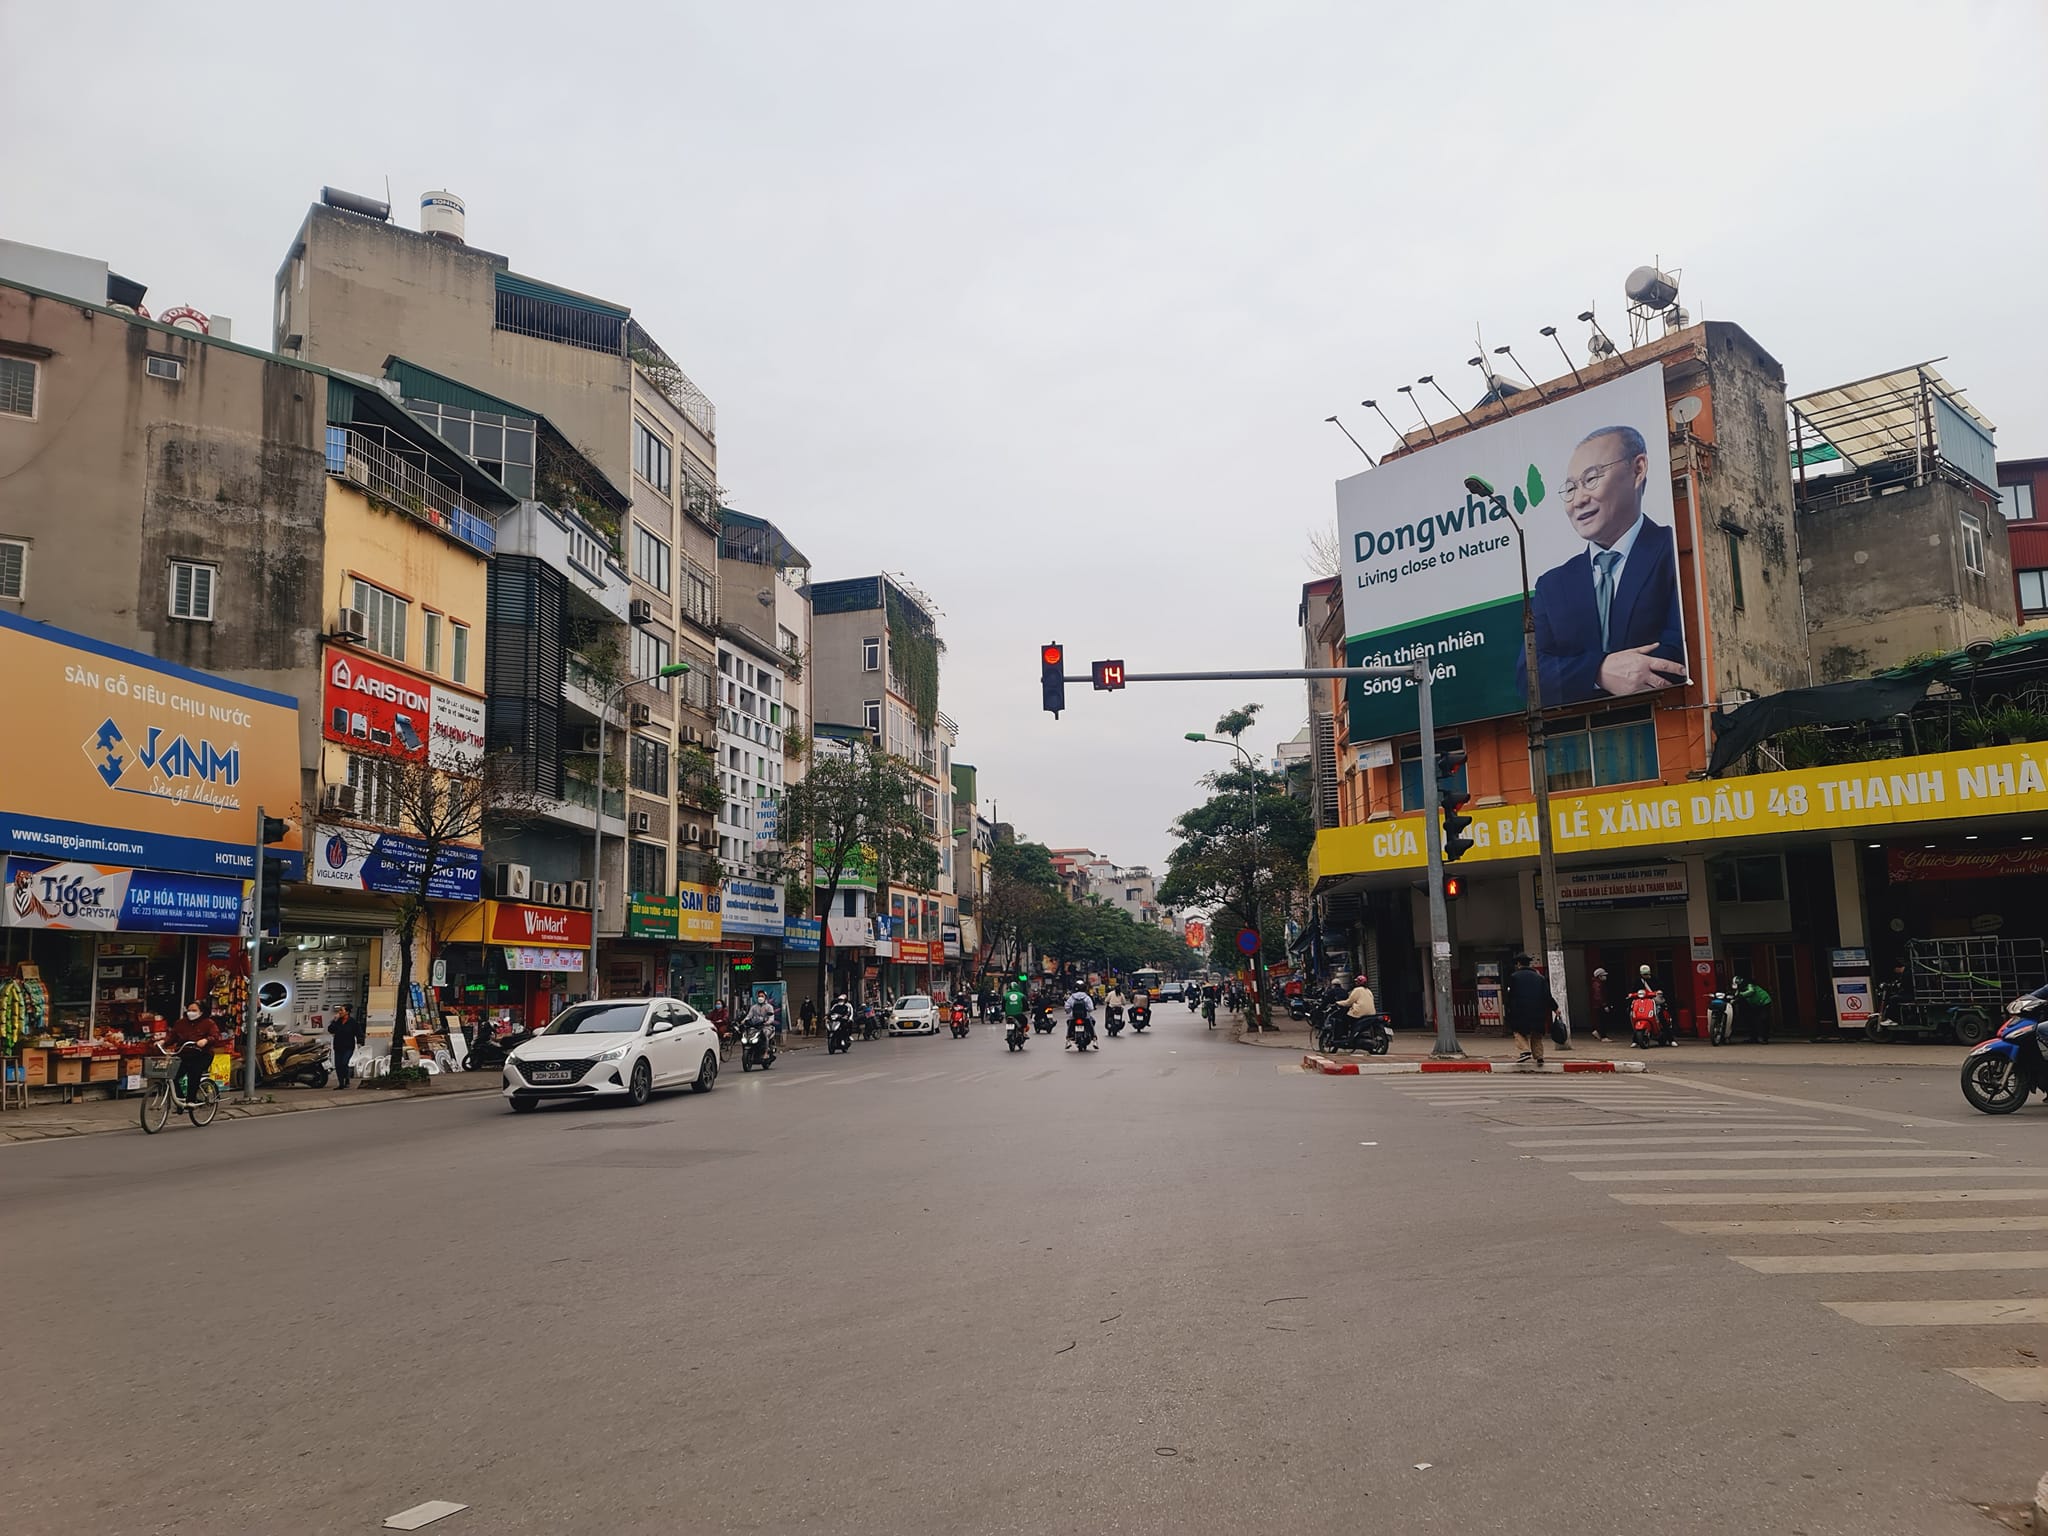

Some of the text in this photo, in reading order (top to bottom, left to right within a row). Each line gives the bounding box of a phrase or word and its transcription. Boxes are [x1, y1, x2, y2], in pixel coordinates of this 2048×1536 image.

[1354, 493, 1508, 563] Dongwha
[1357, 533, 1510, 588] Living close to Nature
[1362, 630, 1484, 669] Gần thiên nhiên
[1104, 666, 1121, 685] 14
[1363, 676, 1402, 696] Sống
[65, 664, 252, 728] SÀN GỖ SIÊU CHỊU NƯỚC
[352, 674, 429, 714] ARISTON
[139, 725, 240, 787] JANMI
[193, 780, 240, 814] Malaysia
[1373, 823, 1418, 858] CỬA
[1559, 800, 1590, 839] LẺ
[1599, 798, 1681, 835] XĂNG
[1691, 783, 1755, 826] DẦU
[1767, 784, 1809, 818] 48
[1818, 770, 1946, 812] THANH
[1957, 752, 2048, 801] NHÀ
[12, 829, 144, 854] www.sangojanmi.com.vn
[316, 869, 353, 880] VIGLACERA
[456, 867, 478, 880] THƠ
[1646, 882, 1665, 892] THANH
[40, 875, 106, 918] Tiger
[130, 887, 238, 910] TẠP HÓA THANH DUNG
[681, 888, 704, 912] SÀN
